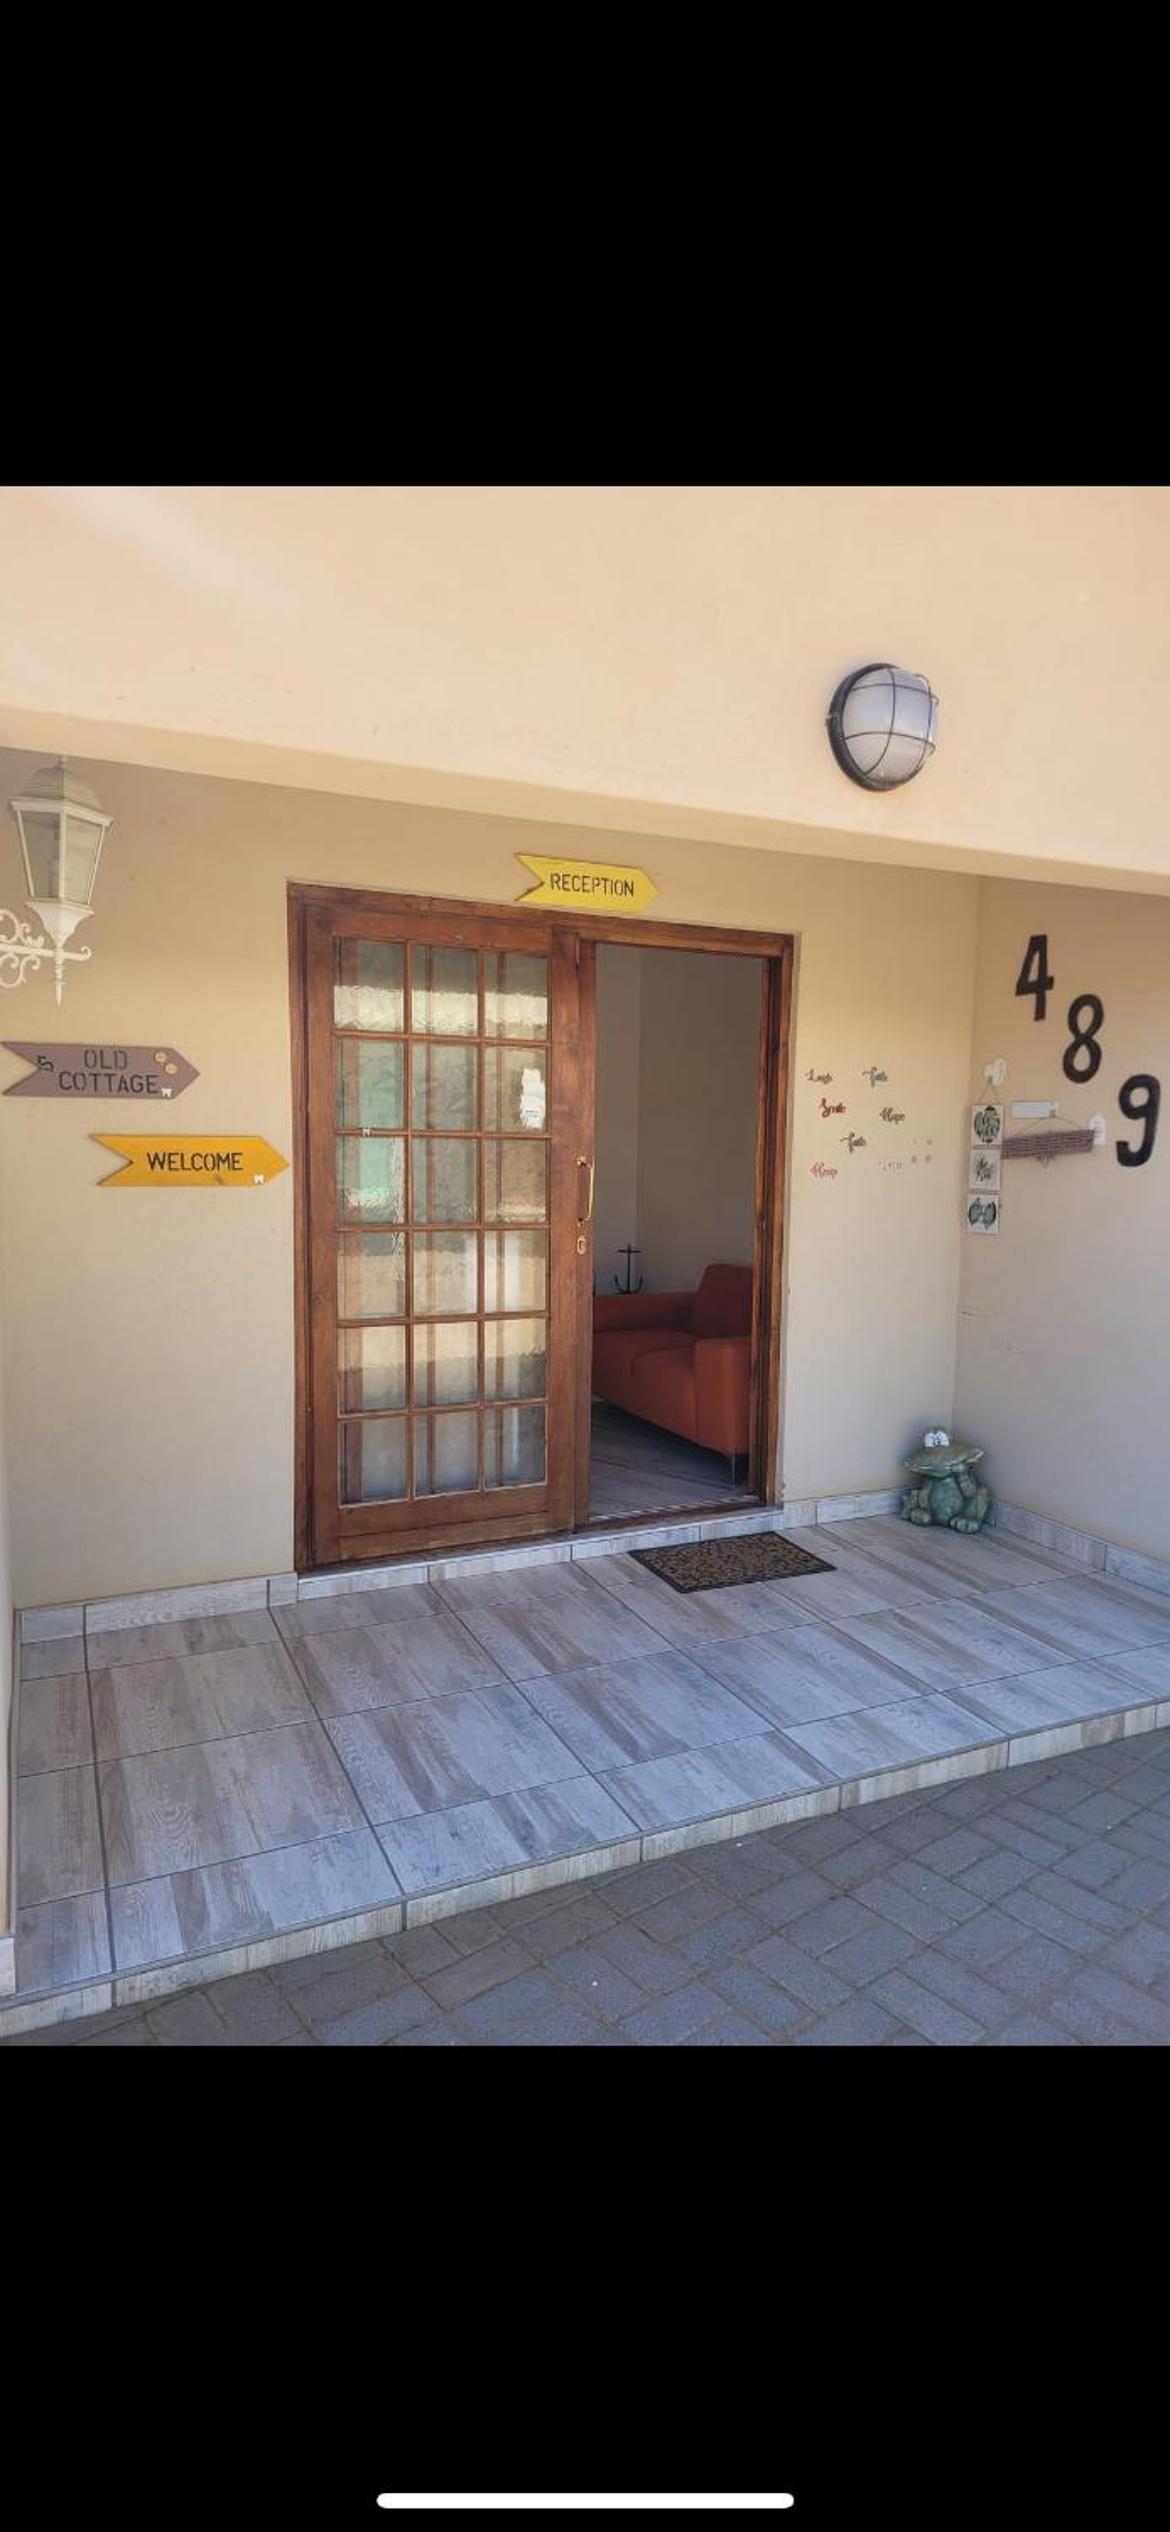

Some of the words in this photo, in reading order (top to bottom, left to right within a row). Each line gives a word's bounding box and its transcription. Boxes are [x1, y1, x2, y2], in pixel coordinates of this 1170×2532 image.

[550, 872, 635, 898] RECEPTION
[83, 1049, 128, 1071] OLD
[58, 1071, 161, 1095] COTTAGE
[146, 1152, 243, 1172] WELCOME
